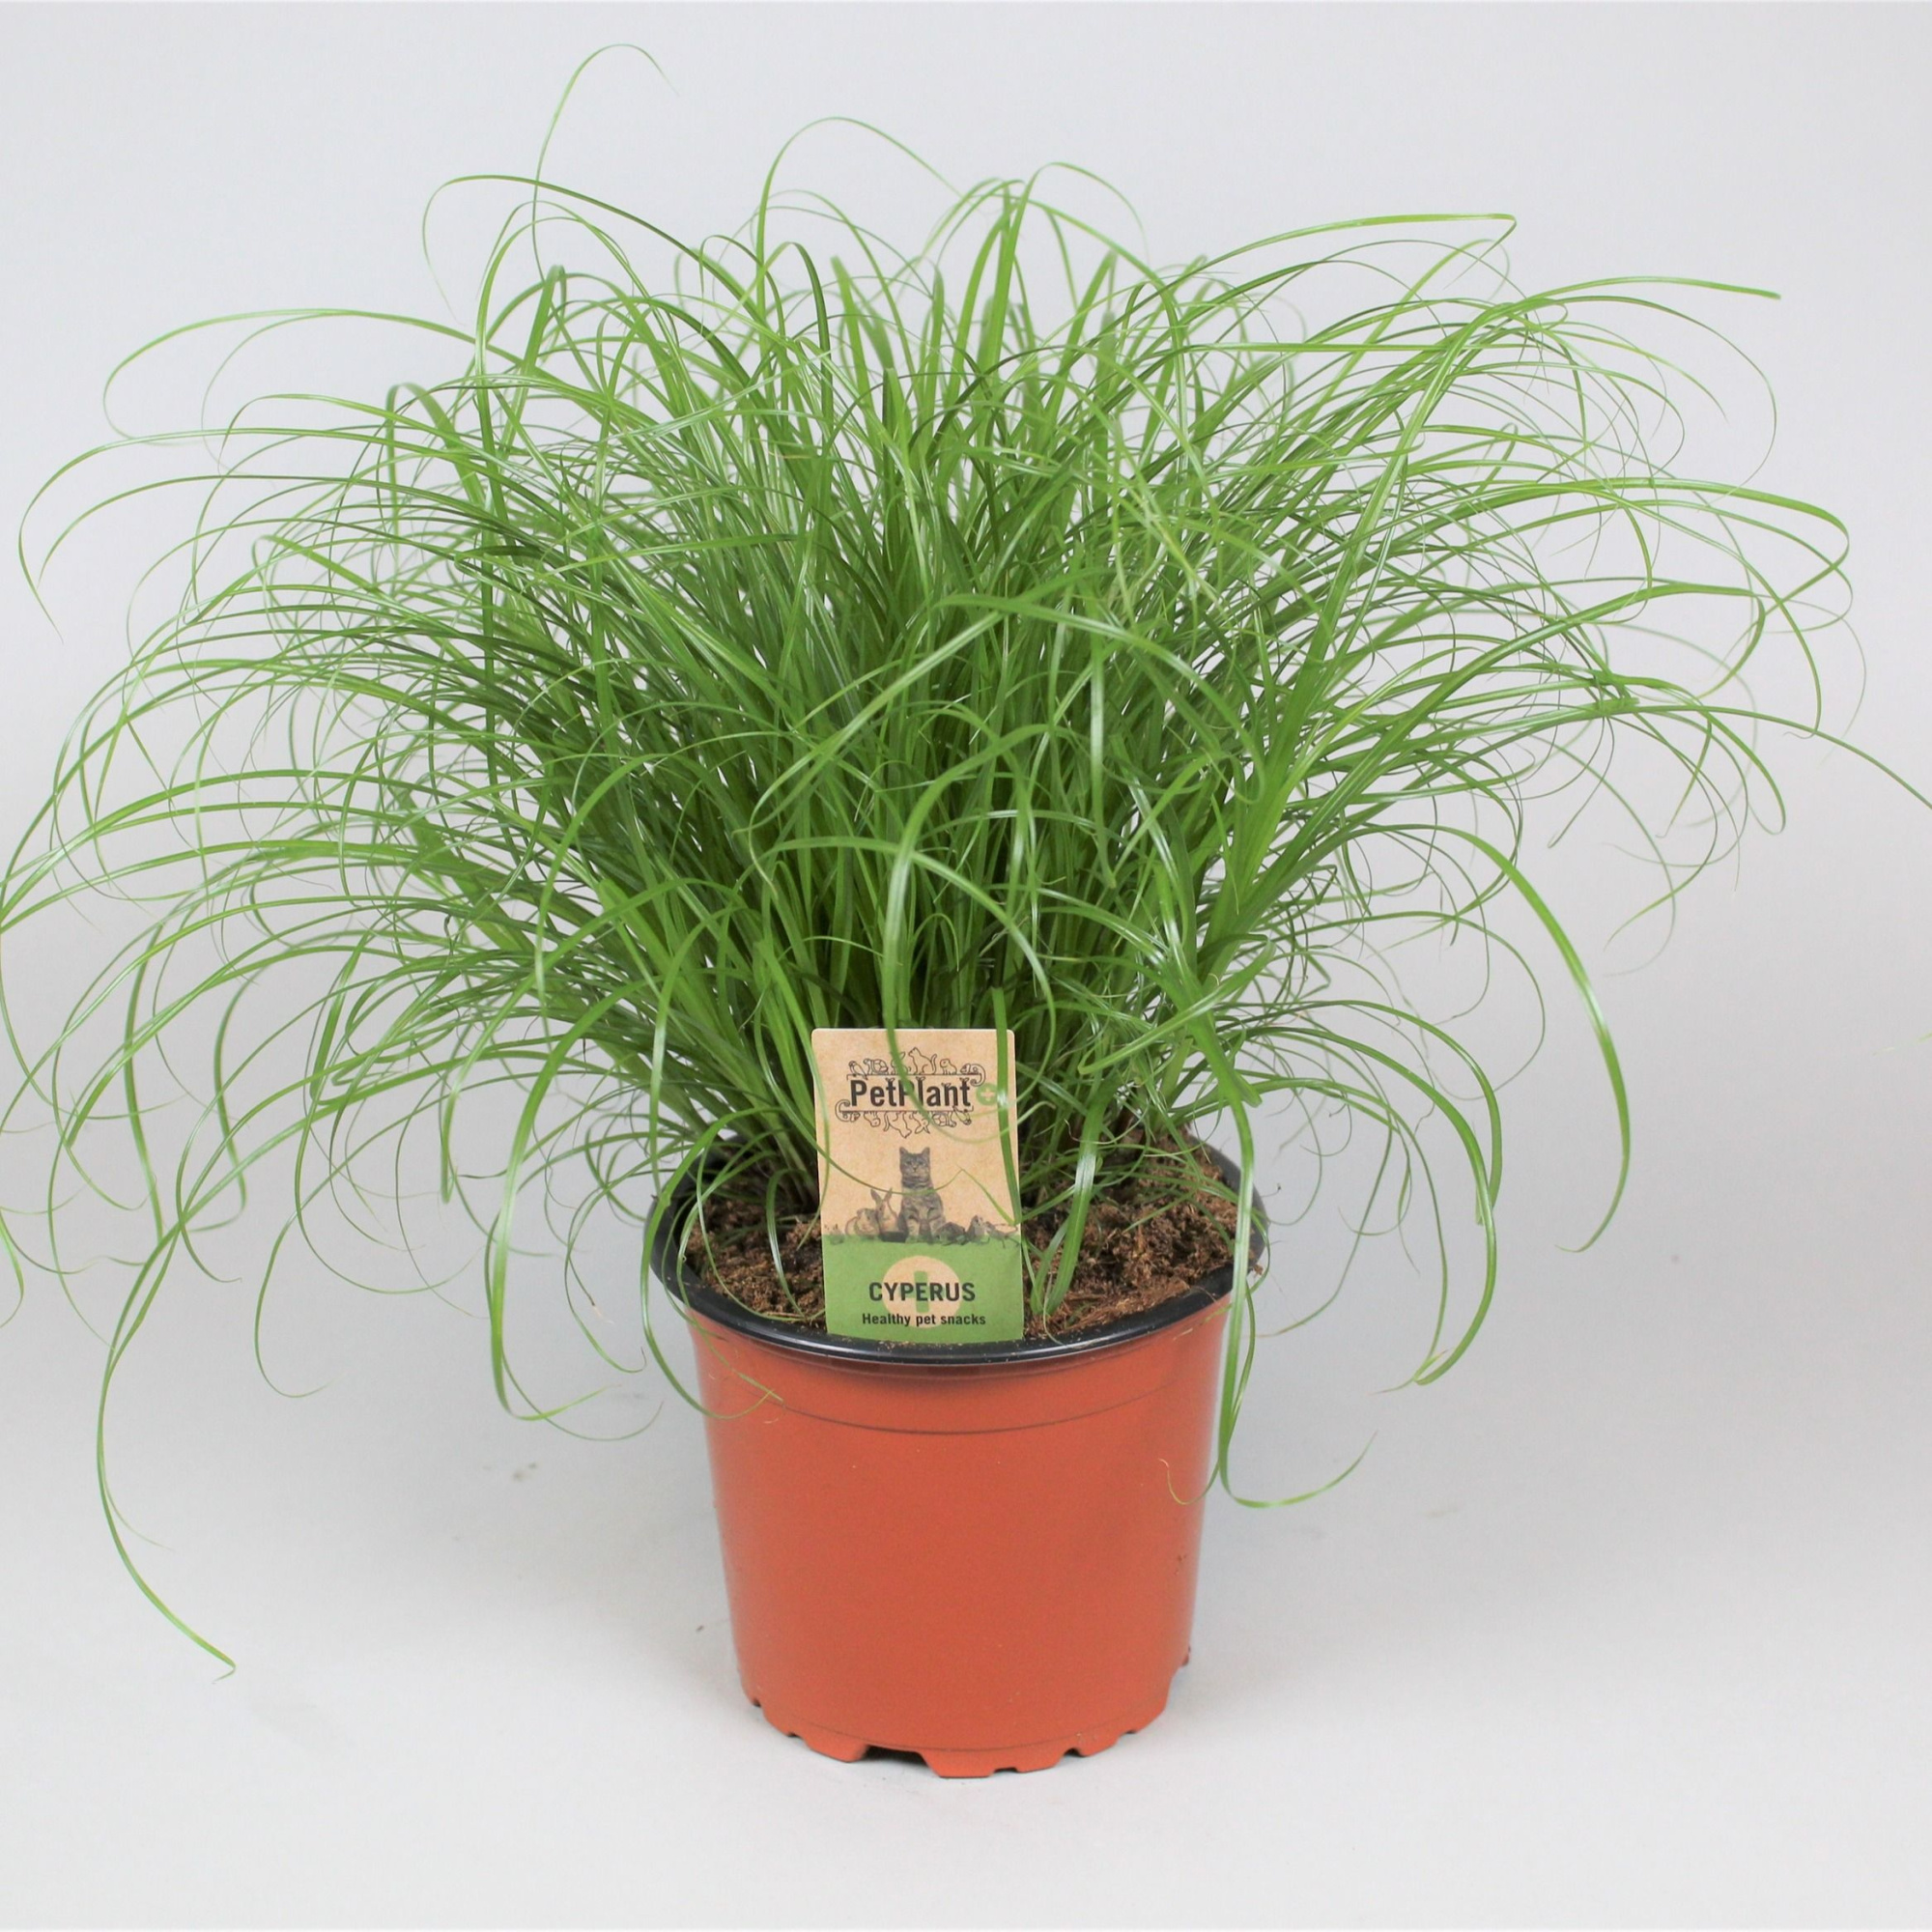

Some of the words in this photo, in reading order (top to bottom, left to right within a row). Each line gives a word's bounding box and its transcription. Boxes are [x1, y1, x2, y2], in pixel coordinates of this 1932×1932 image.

[869, 1282, 976, 1302] CYPERUS
[863, 1314, 911, 1327] Healthy
[917, 1315, 936, 1327] pet
[941, 1315, 986, 1325] snacks
